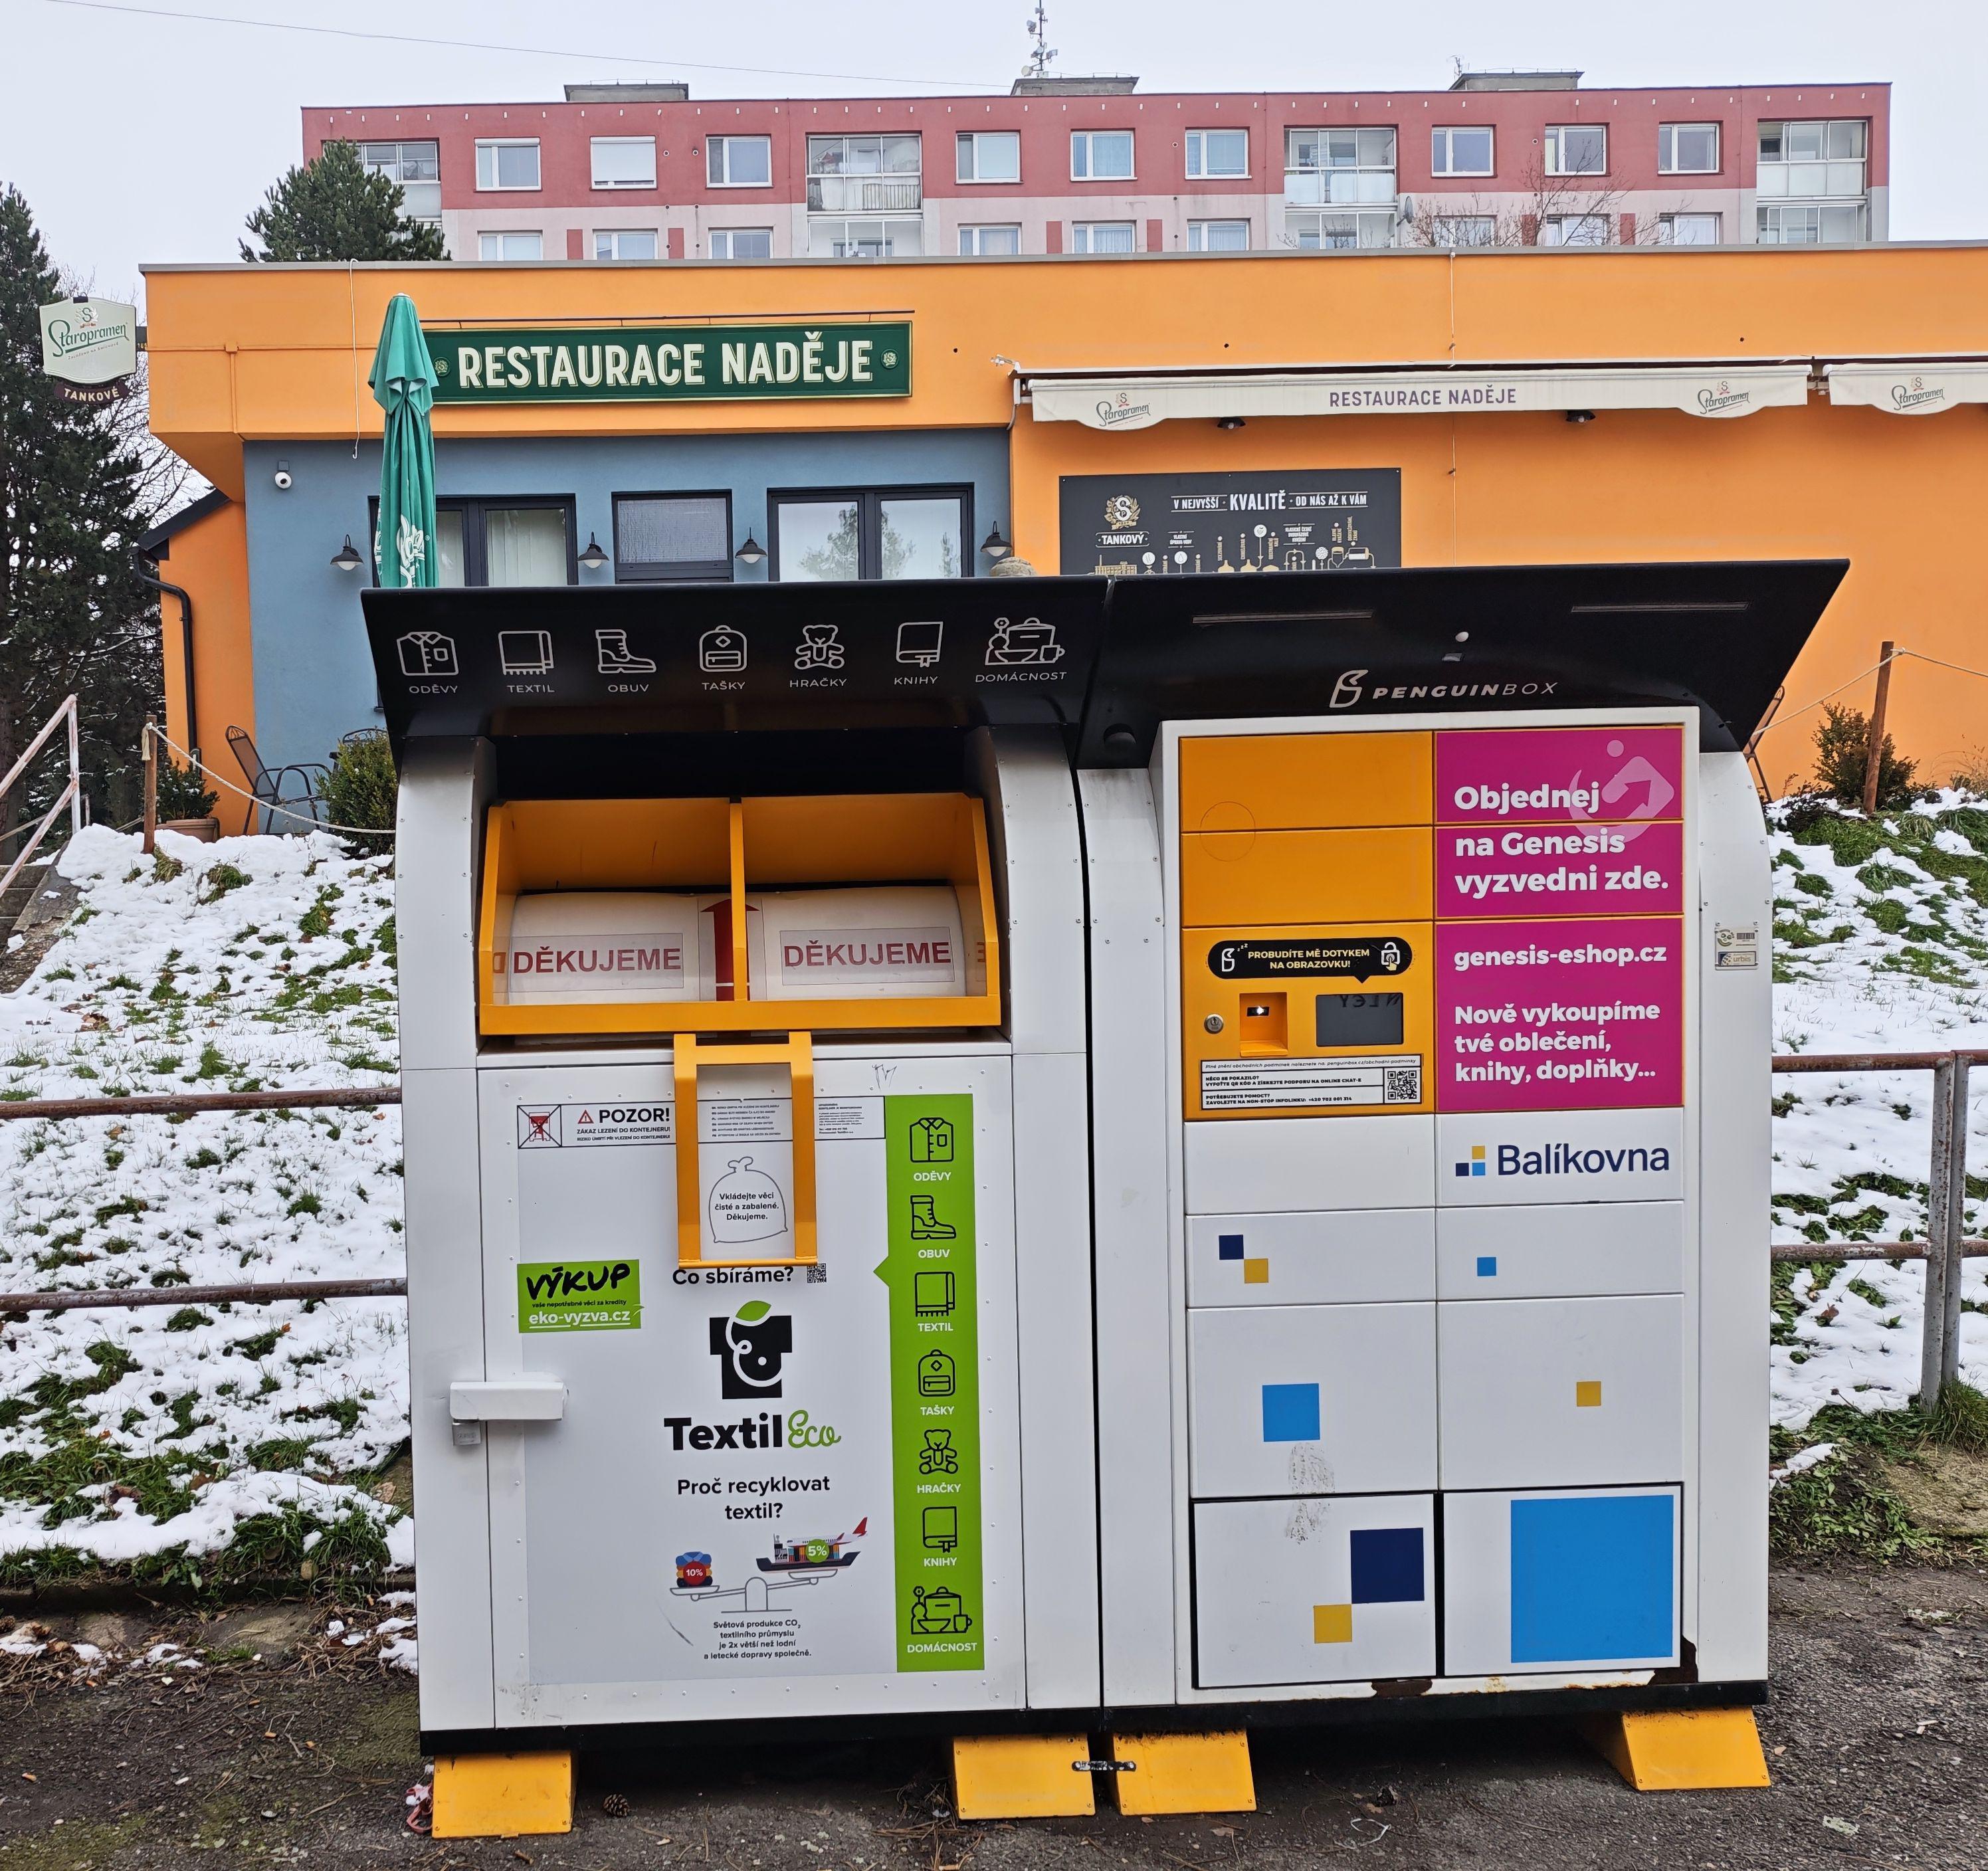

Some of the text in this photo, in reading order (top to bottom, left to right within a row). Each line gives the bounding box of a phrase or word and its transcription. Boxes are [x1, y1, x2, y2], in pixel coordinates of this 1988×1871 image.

[48, 320, 130, 357] Staropramen
[458, 331, 873, 388] RESTAURACE NADĚJE
[64, 386, 120, 402] TANKOVÉ
[1330, 384, 1516, 407] RESTAURACE NADĚJE
[1698, 389, 1750, 414] Staropramen
[1892, 385, 1945, 411] Staropramen
[1096, 401, 1151, 427] Staropramen
[1173, 490, 1367, 511] V NEJVYŠŠÍ KVALITĚ OD NÁS AŽ K VÁM
[1102, 532, 1144, 544] TANKOVÝ
[789, 677, 847, 688] HRAČKY
[894, 676, 939, 685] KNIHY
[975, 671, 1068, 682] DOMÁCNOST
[409, 684, 458, 694] ODĚVY
[506, 684, 555, 694] TEXTIL
[607, 684, 649, 693] OBUV
[701, 680, 746, 690] TAŠKY
[1372, 682, 1558, 700] PENGUINBOX
[1454, 781, 1599, 815] Objednej
[1456, 828, 1625, 856] na Genesis
[1454, 864, 1669, 899] vyzvedni zde.
[513, 946, 682, 975] DĚKUJEME
[784, 939, 951, 967] DĚKUJEME
[1248, 948, 1369, 959] PROBUDÍTE MĚ DOTYKEM
[1454, 944, 1667, 971] genesis-eshop.cz
[1286, 960, 1350, 969] OBRAZOVKU!
[1455, 1001, 1660, 1027] Nově vykoupíme
[1454, 1030, 1611, 1053] tvé oblečení,
[1456, 1058, 1656, 1085] knihy, doplňky...
[599, 1108, 670, 1123] POZOR!
[1498, 1143, 1670, 1176] Balíkovna
[914, 1170, 952, 1182] ODĚVY
[720, 1192, 756, 1201] Vkládejte
[918, 1249, 950, 1258] OBUV
[526, 1263, 631, 1300] VÝKUP
[672, 1266, 794, 1285] Co sbíráme?
[529, 1311, 631, 1326] eko-vyzva.cz
[918, 1323, 953, 1332] TEXTIL
[920, 1405, 955, 1416] TAŠKY
[678, 1476, 831, 1496] Proč recyklovat
[917, 1482, 961, 1494] HRAČKY
[725, 1502, 783, 1520] textil?
[807, 1545, 827, 1557] 5%
[924, 1557, 957, 1567] KNIHY
[747, 1620, 783, 1628] produkce
[759, 1630, 794, 1638] průmyslu
[719, 1642, 726, 1650] je
[907, 1642, 977, 1653] DOMÁCNOST
[741, 1650, 772, 1659] dopravy
[774, 1649, 812, 1658] společně.
